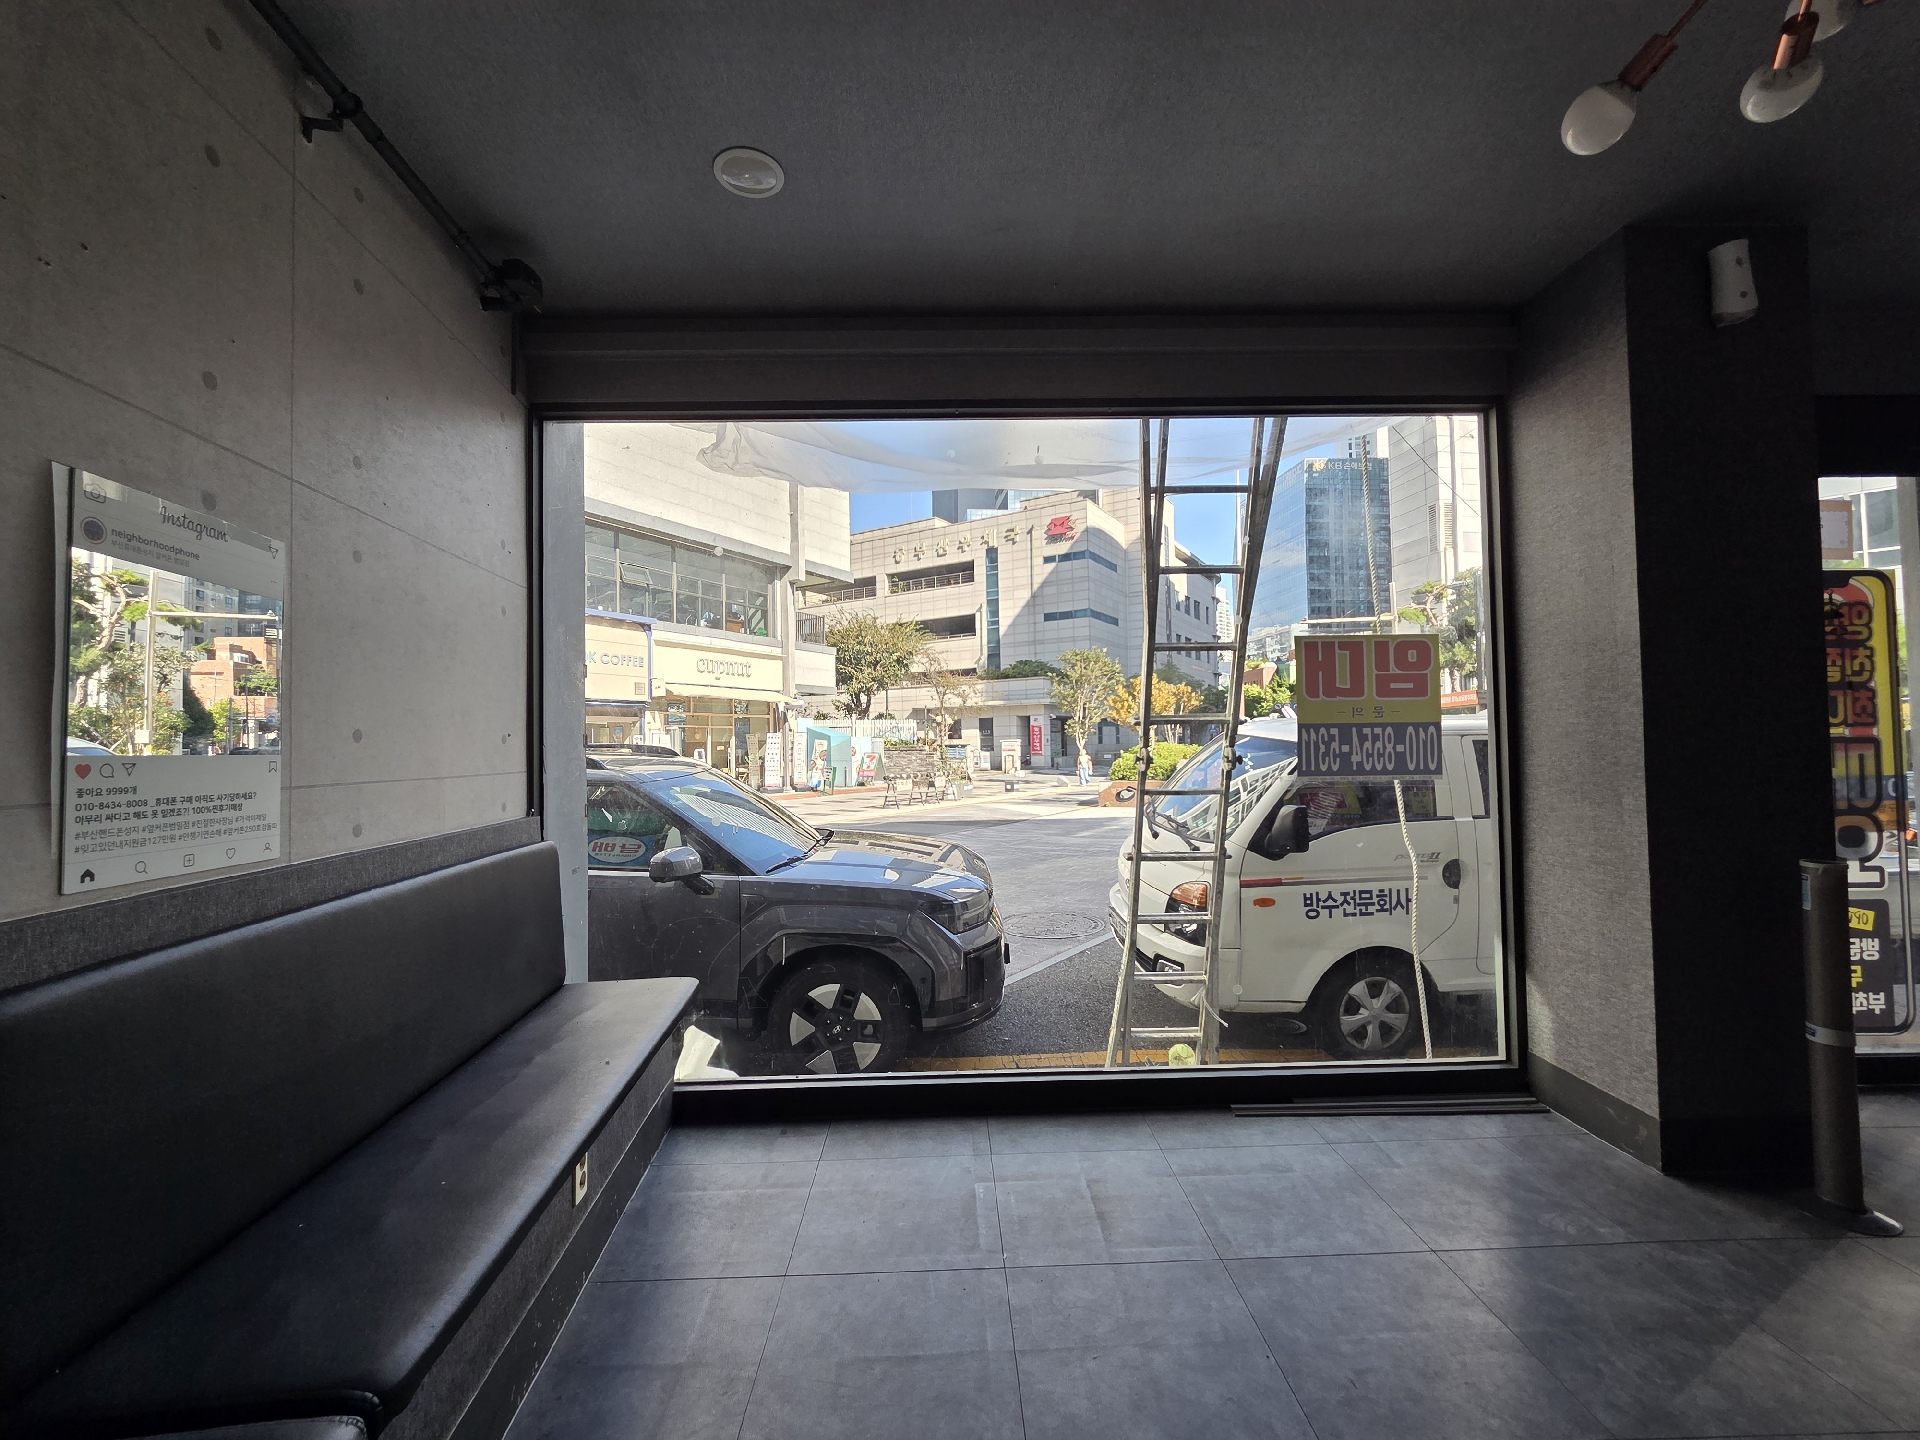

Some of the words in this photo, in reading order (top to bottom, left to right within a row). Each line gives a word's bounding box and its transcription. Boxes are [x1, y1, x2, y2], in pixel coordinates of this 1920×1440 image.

[160, 505, 229, 543] Instagram
[111, 528, 200, 561] neighborhoodphone
[600, 652, 645, 668] COFFEE
[696, 658, 752, 680] cupnut
[75, 787, 103, 799] 좋아요
[105, 785, 137, 796] 9999개
[75, 799, 148, 812] 010-8434-8008
[179, 795, 193, 805] 구매
[194, 794, 215, 804] 아직도
[216, 791, 257, 802] 사기당하세요?
[74, 814, 102, 825] 아무리
[105, 811, 131, 823] 싸다고
[132, 810, 149, 820] 해도
[151, 809, 159, 819] 못
[74, 825, 139, 840] #부산핸드폰성지
[1302, 887, 1413, 920] 방수전문회사
